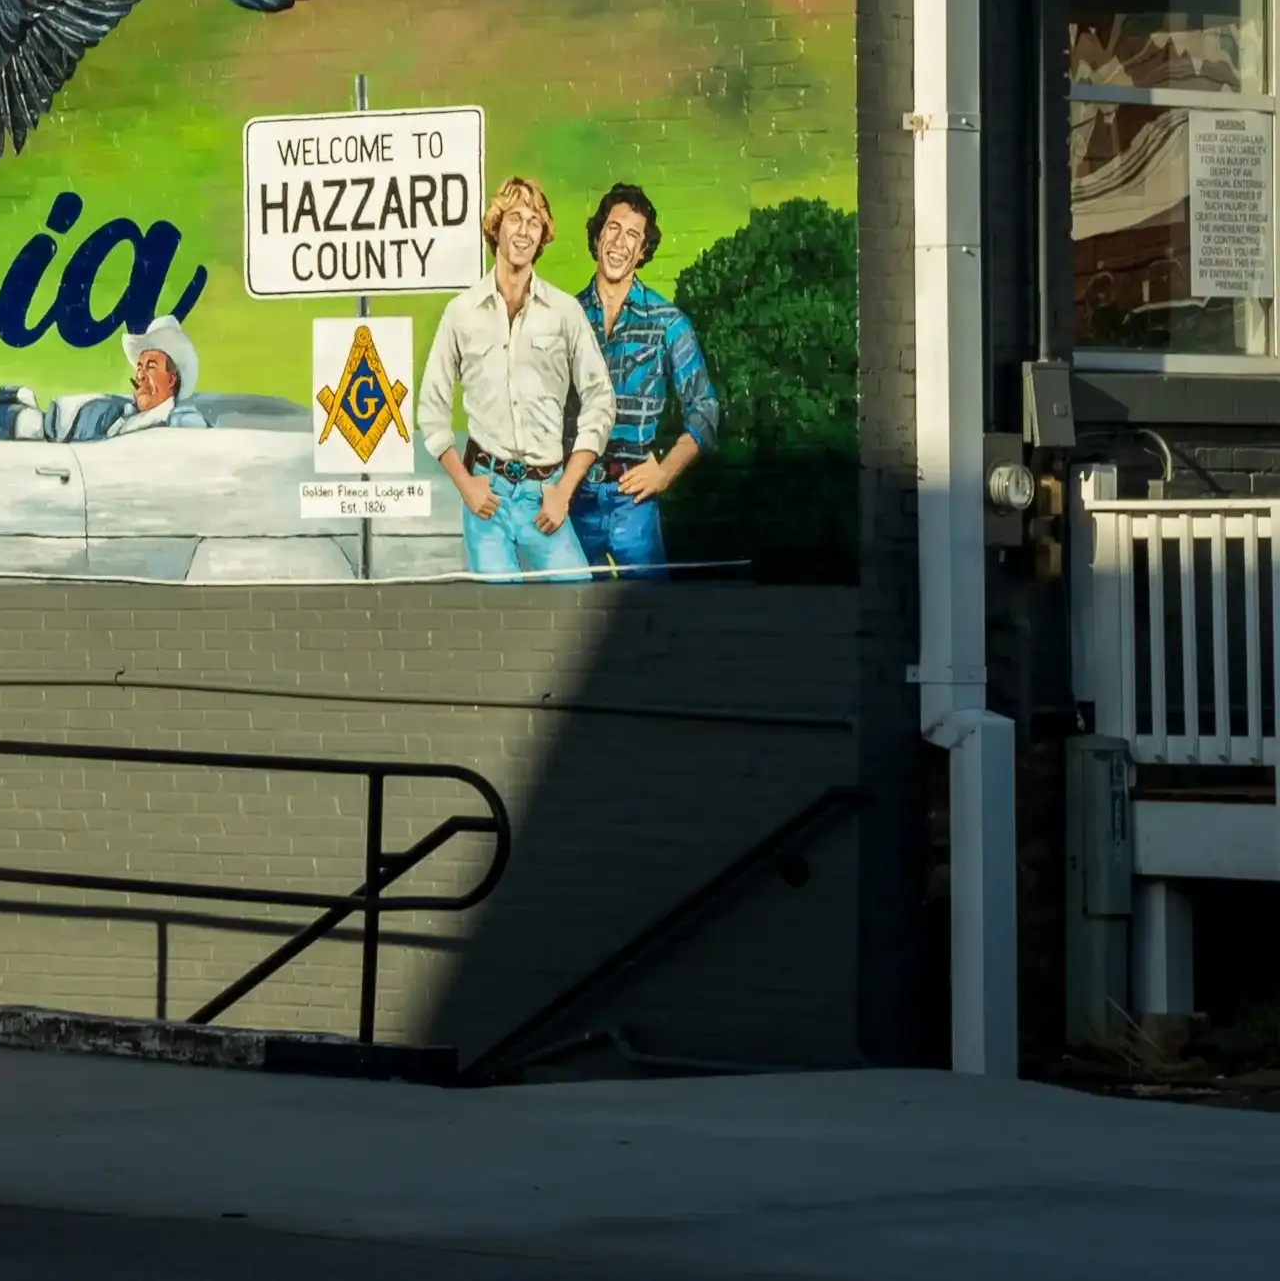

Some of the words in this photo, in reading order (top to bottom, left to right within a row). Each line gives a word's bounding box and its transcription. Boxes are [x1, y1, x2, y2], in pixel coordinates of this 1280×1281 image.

[277, 133, 394, 167] WELCOME
[412, 130, 444, 160] TO
[260, 172, 469, 235] HAZZARD
[291, 237, 436, 282] COUNTY
[302, 485, 334, 498] Golden
[338, 484, 369, 498] Fleece
[375, 484, 405, 501] Lodge
[340, 501, 362, 514] Est.
[364, 500, 387, 514] 1826
